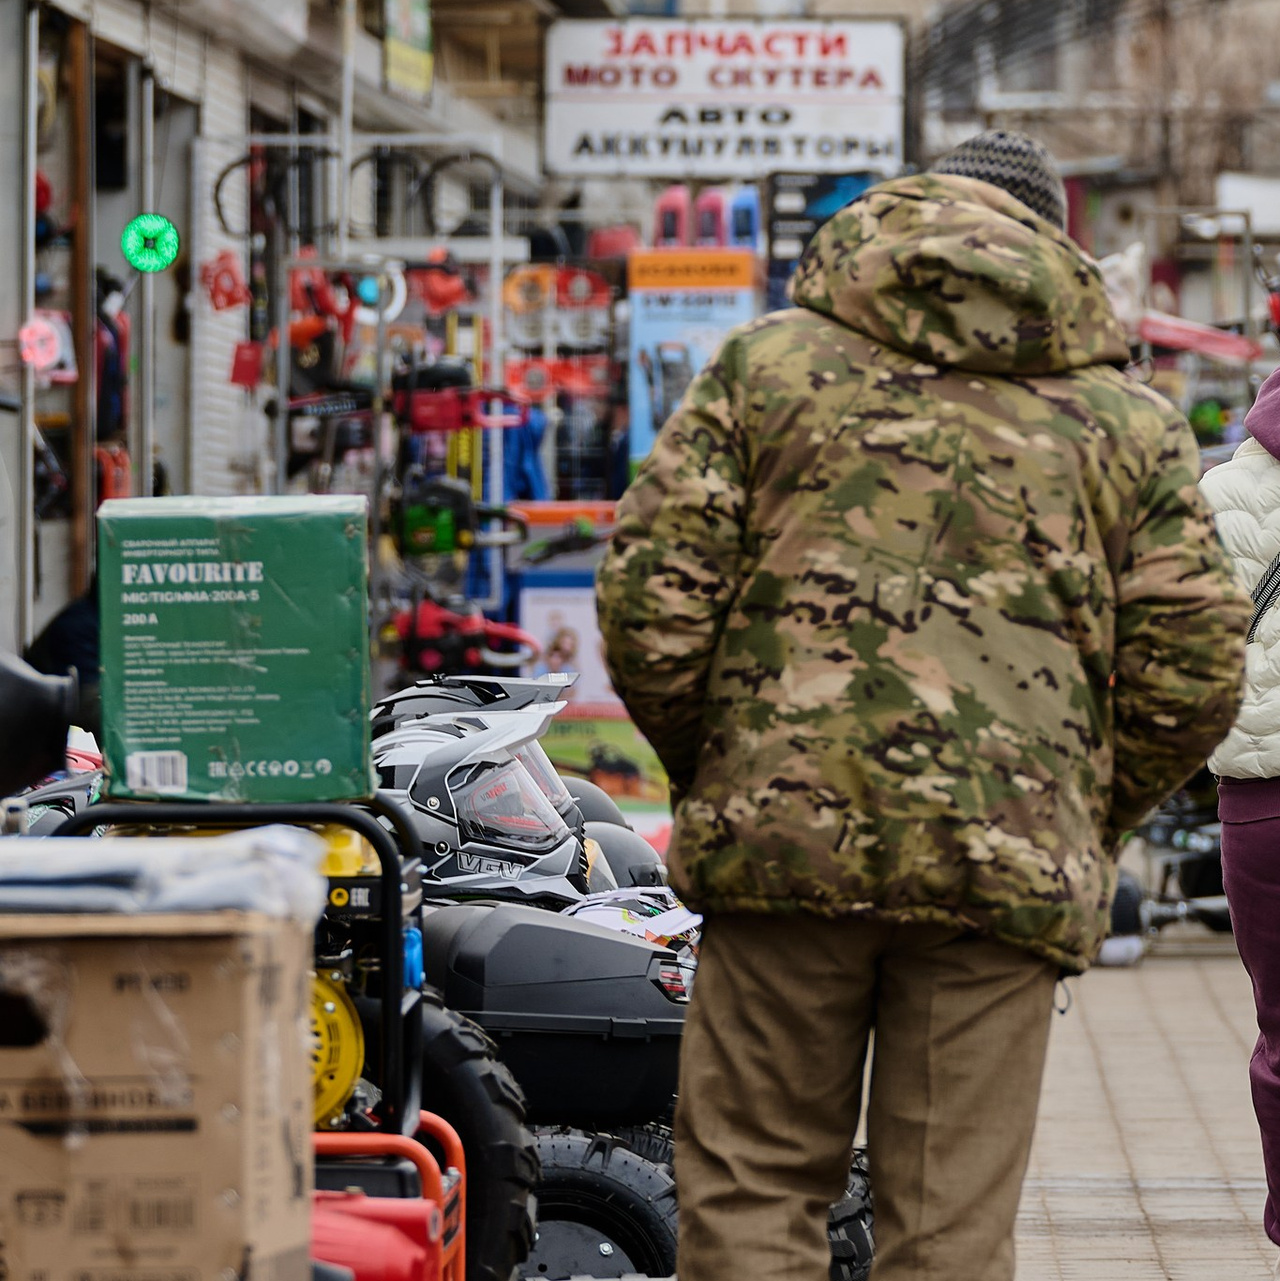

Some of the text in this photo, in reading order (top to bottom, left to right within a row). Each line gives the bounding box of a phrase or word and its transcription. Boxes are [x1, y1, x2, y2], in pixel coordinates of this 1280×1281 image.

[605, 30, 847, 60] ЗАПЧАСТИ
[563, 65, 884, 89] МОТО СКУТЕРА
[659, 106, 793, 125] АВТО
[121, 561, 264, 585] FAVOURITE
[122, 612, 159, 625] 200 A
[456, 851, 525, 882] VGV
